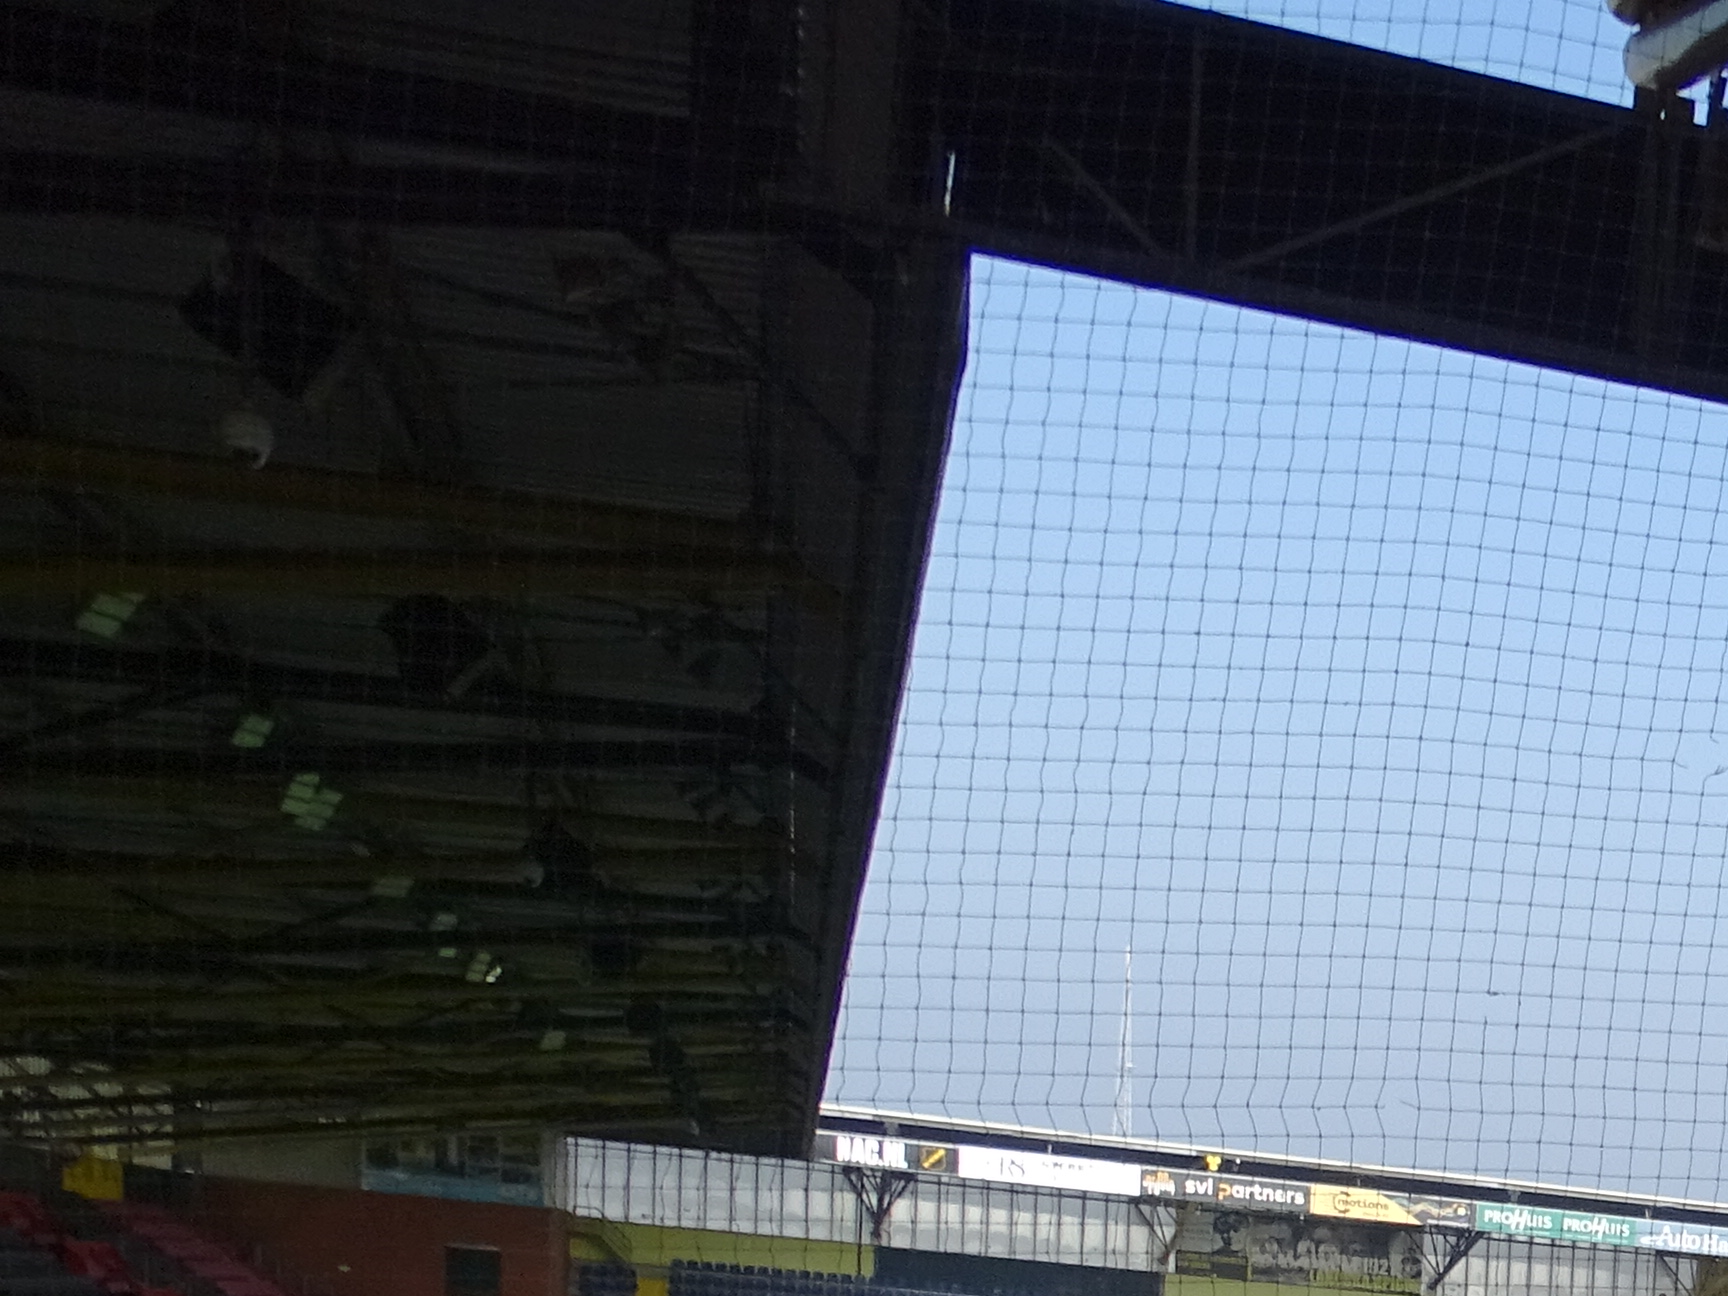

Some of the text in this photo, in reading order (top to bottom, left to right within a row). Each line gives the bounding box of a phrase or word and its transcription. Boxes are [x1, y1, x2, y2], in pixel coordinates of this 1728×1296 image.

[836, 1136, 909, 1169] NAC.NL
[1217, 1180, 1305, 1206] partners
[1658, 1224, 1701, 1250] Auto
